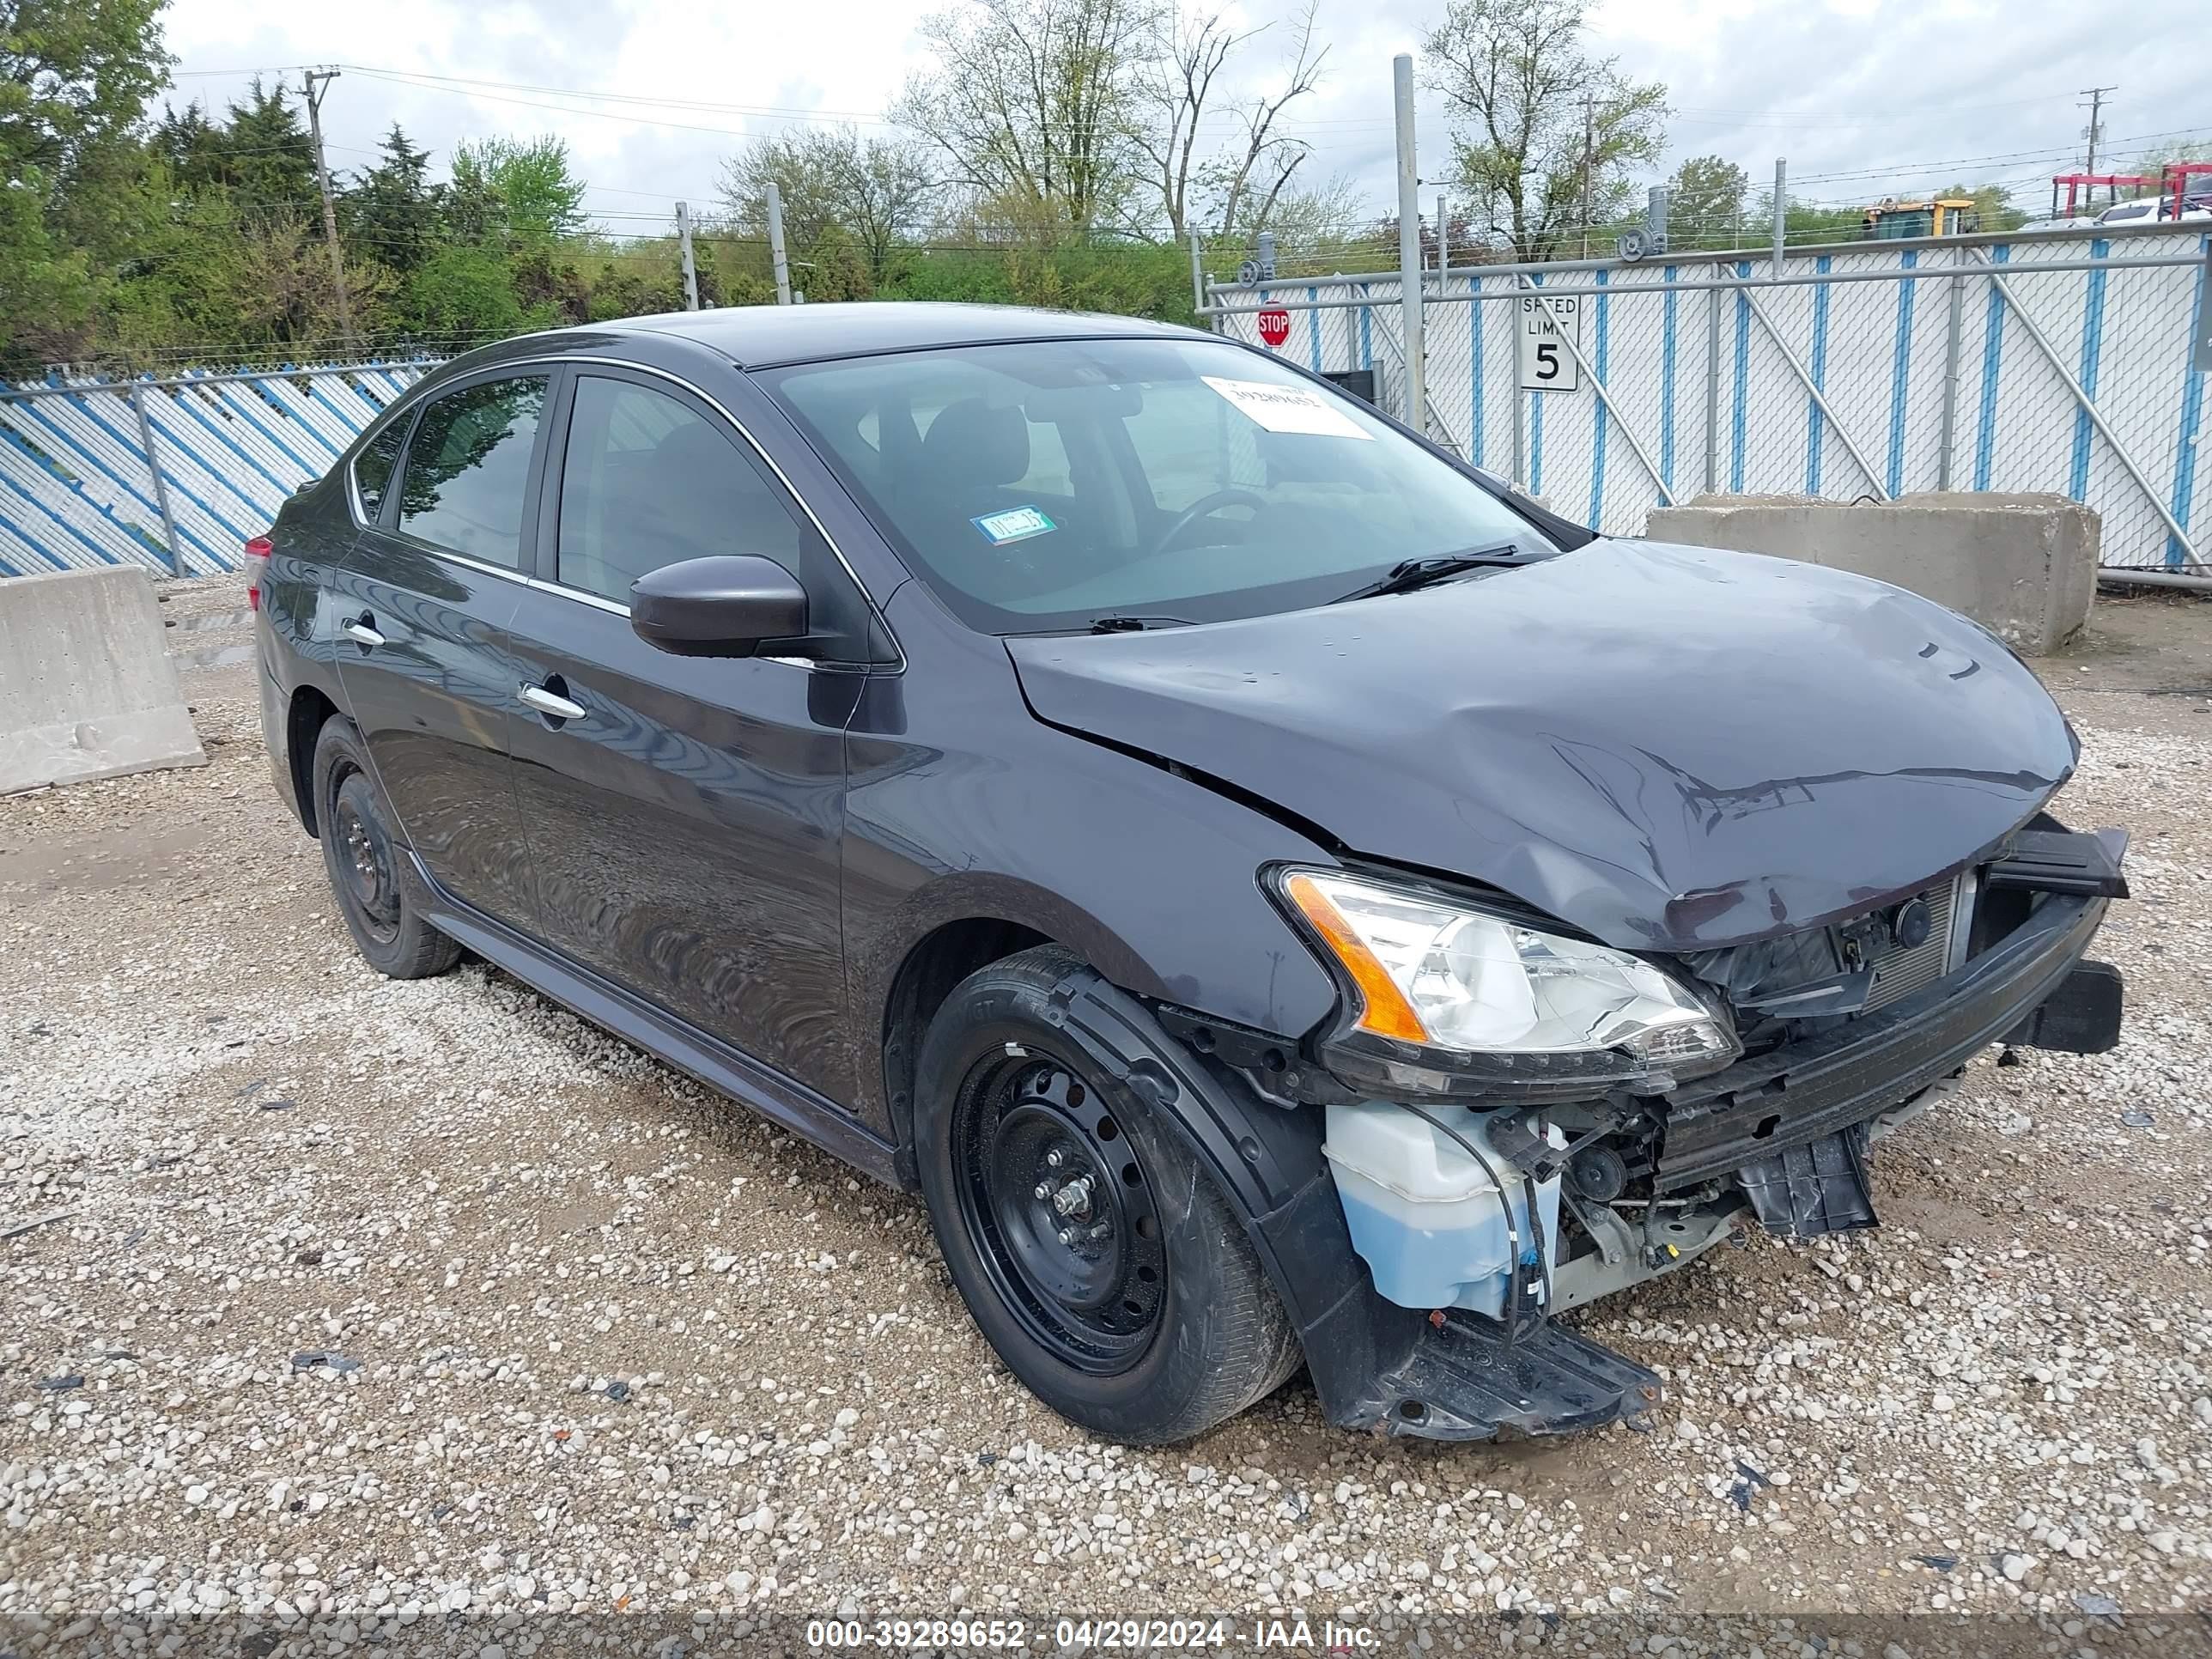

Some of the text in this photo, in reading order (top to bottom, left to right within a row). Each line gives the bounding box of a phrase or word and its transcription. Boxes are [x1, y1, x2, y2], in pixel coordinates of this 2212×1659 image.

[1523, 298, 1576, 313] SPED
[1260, 314, 1288, 332] STOP
[1536, 343, 1559, 380] 5
